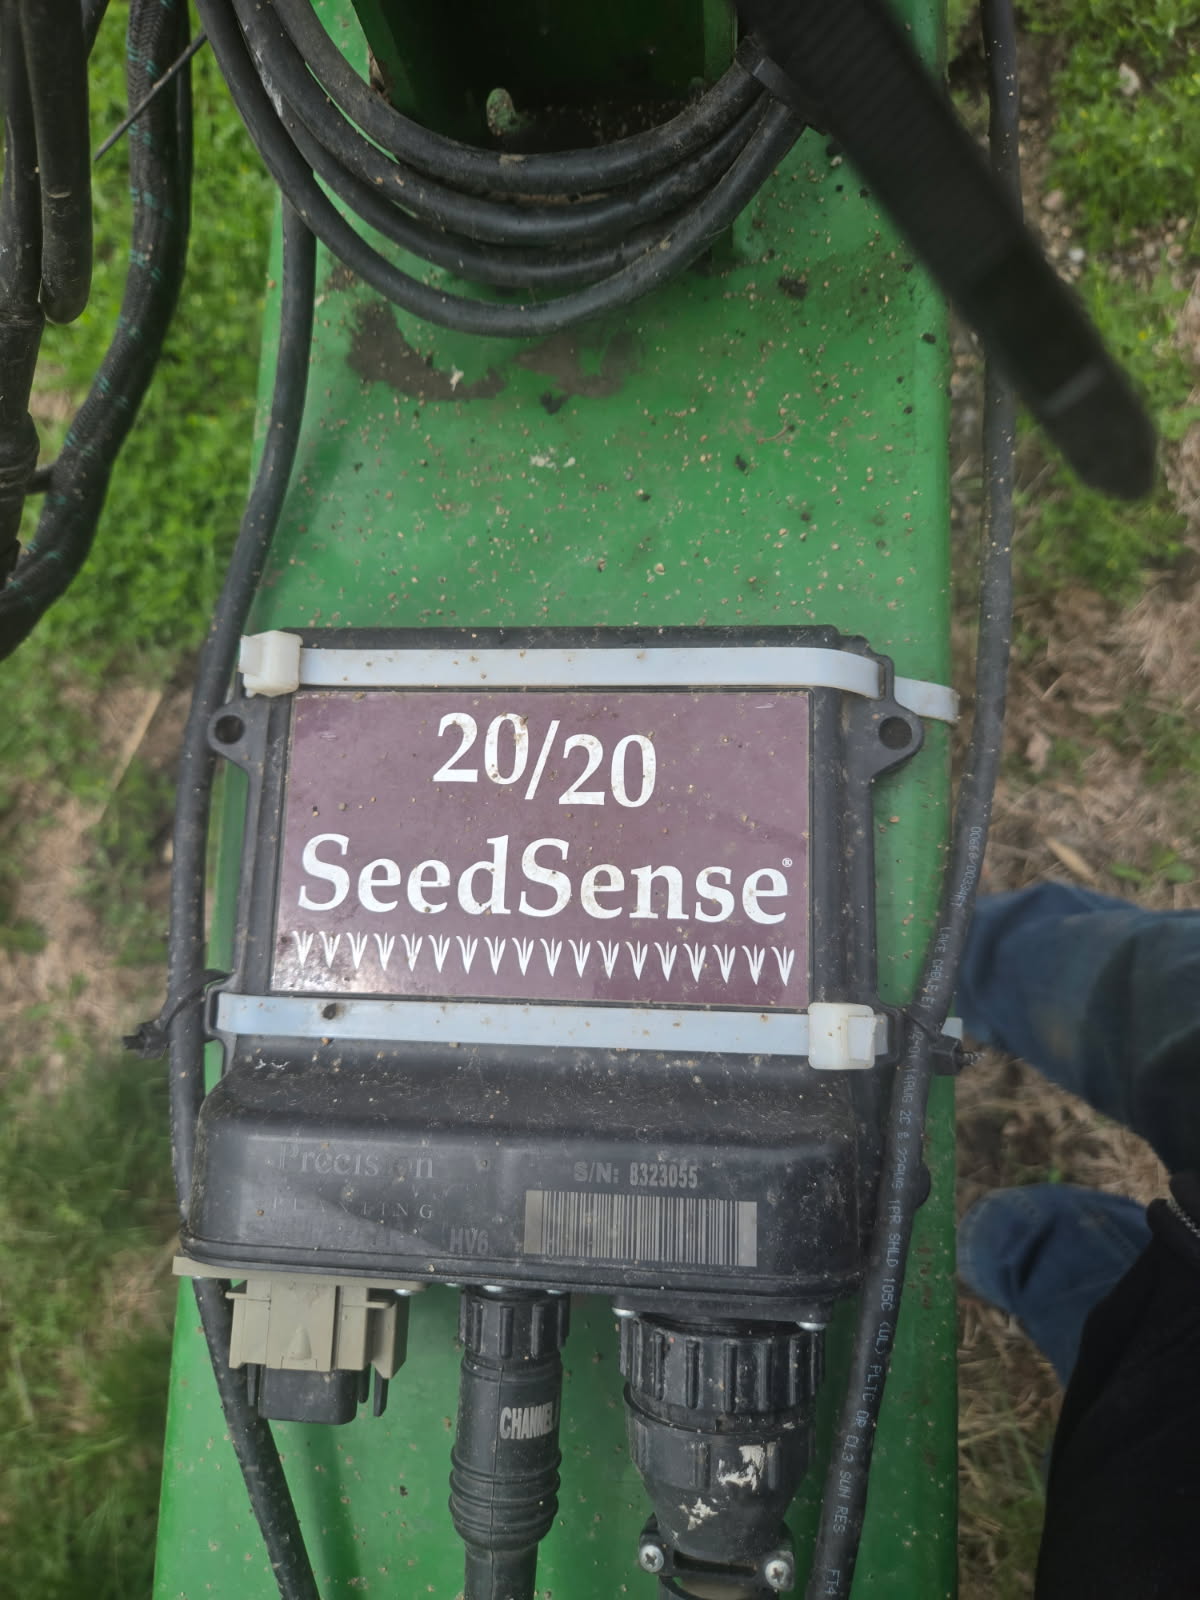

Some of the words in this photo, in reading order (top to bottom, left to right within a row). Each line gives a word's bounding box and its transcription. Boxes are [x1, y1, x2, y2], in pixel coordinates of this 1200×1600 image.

[433, 712, 657, 808] 20/20
[934, 926, 953, 953] LAKE
[925, 958, 945, 992] CABLE
[278, 1142, 433, 1178] Precisn
[573, 1161, 620, 1184] S/N:
[886, 1232, 901, 1267] SHLD
[879, 1277, 896, 1312] 105C
[874, 1321, 892, 1355] (UL)
[862, 1365, 883, 1401] PLTC
[841, 1434, 860, 1464] CL3
[837, 1470, 853, 1499] SUN
[832, 1505, 850, 1536] RES
